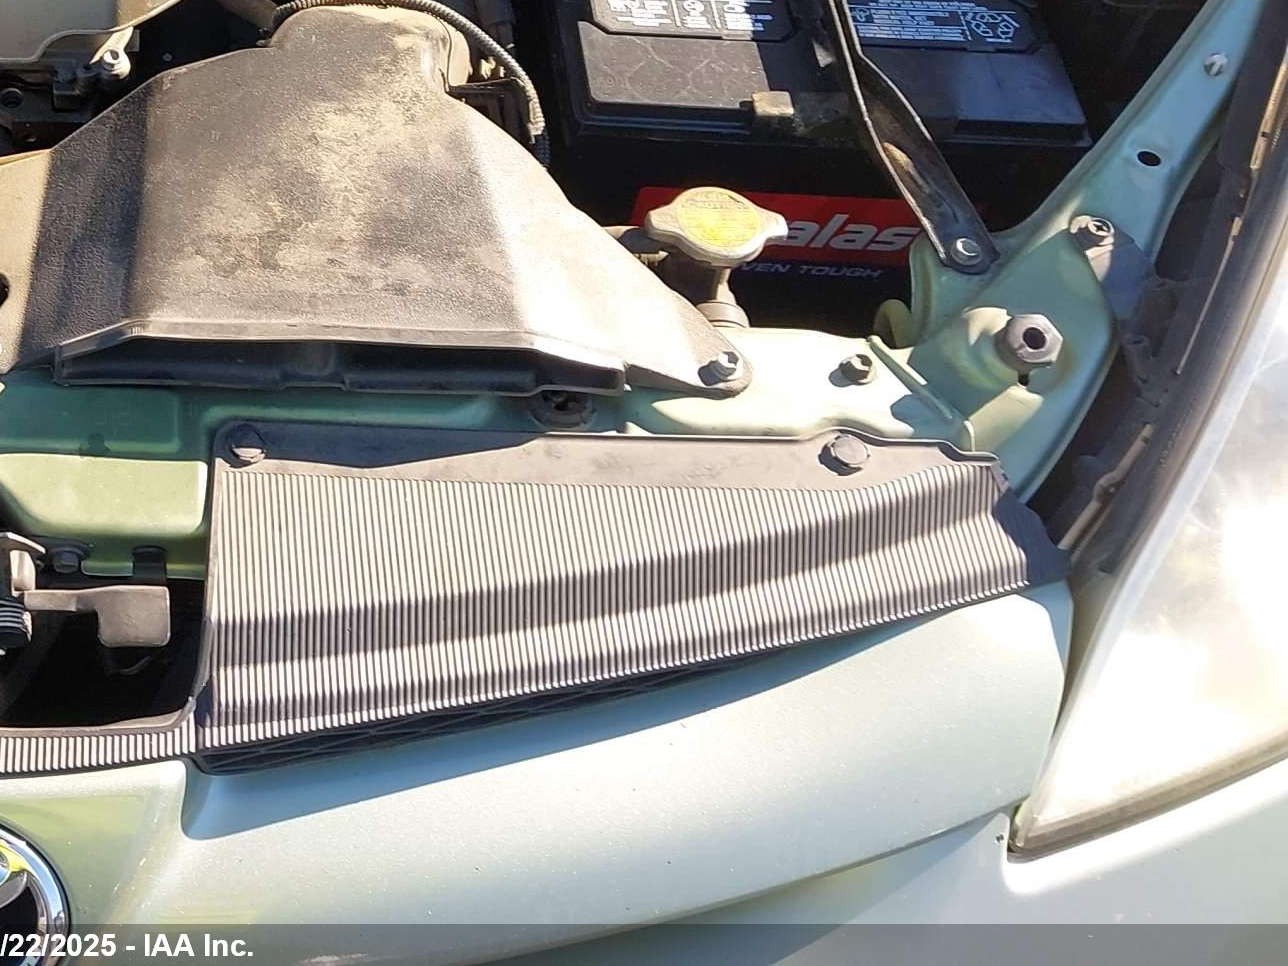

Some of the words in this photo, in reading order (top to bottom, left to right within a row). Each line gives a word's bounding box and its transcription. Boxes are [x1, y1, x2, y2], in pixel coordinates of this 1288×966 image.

[786, 213, 922, 251] alas
[740, 263, 792, 273] VEN
[799, 265, 883, 279] TOUGH
